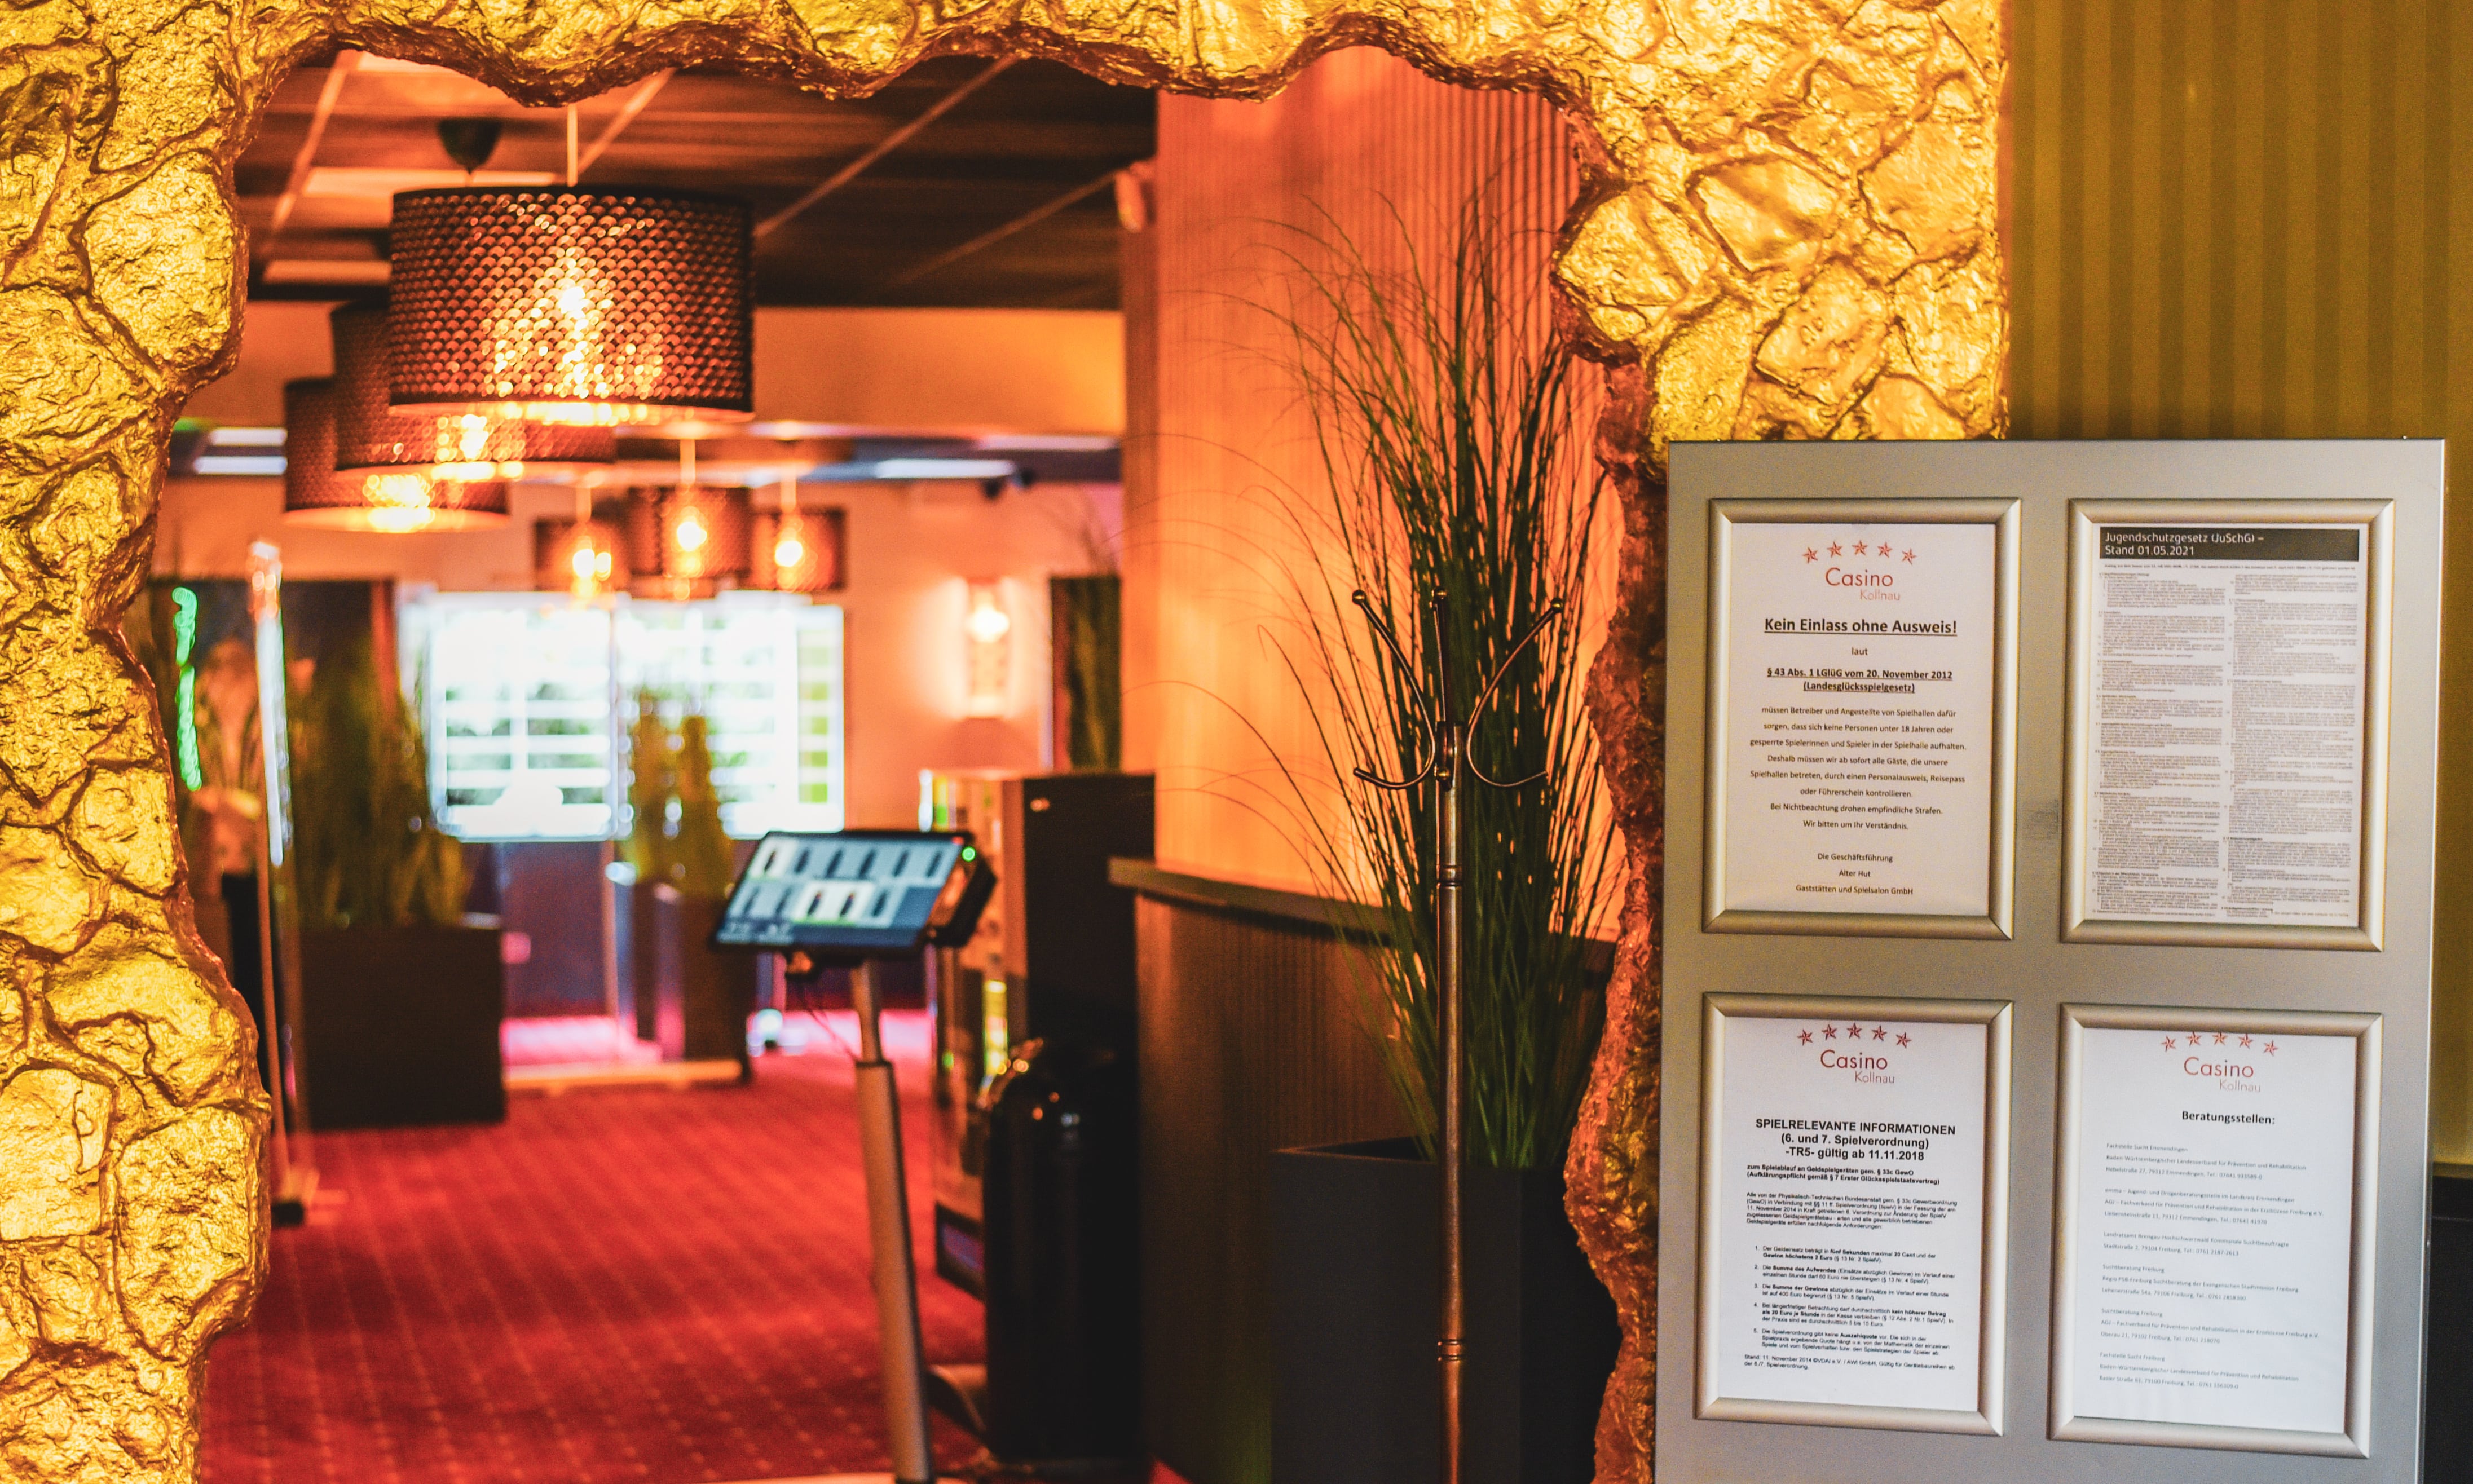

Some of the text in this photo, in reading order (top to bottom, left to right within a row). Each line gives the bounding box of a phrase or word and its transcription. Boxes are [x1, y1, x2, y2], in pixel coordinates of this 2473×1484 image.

[2105, 533, 2208, 544] Jugendschutzgesetz
[2211, 533, 2255, 542] (JuSchG)
[2104, 545, 2194, 555] Stand 01.05.2021
[1826, 567, 1893, 586] Casino
[1859, 589, 1901, 600] Kollnau
[1765, 617, 1956, 633] Kein Einlass ohne Ausweis!
[1767, 668, 1773, 677] §
[1773, 668, 1785, 677] 43
[1787, 668, 1806, 678] Abs.
[1809, 669, 1814, 678] 1
[1867, 669, 1879, 679] 20.
[1883, 670, 1928, 679] November
[1931, 671, 1952, 680] 2012
[1803, 682, 1915, 693] (Landesglücksspielgesetz)
[1783, 803, 1839, 812] Nichtbeachtung
[1831, 853, 1893, 862] Geschäftsführung
[1820, 1050, 1888, 1070] Casino
[2184, 1057, 2254, 1077] Casino
[1854, 1071, 1894, 1083] Kollnau
[2219, 1079, 2261, 1092] Kollnau
[2182, 1111, 2274, 1124] Beratungsstellen:
[1756, 1119, 1955, 1134] SPIELRELEVANTE INFORMATIONEN
[1781, 1133, 1929, 1149] (6. und 7. Spielverordnung)
[1786, 1146, 1924, 1160] -TR5- gültig ab 11.11.2018
